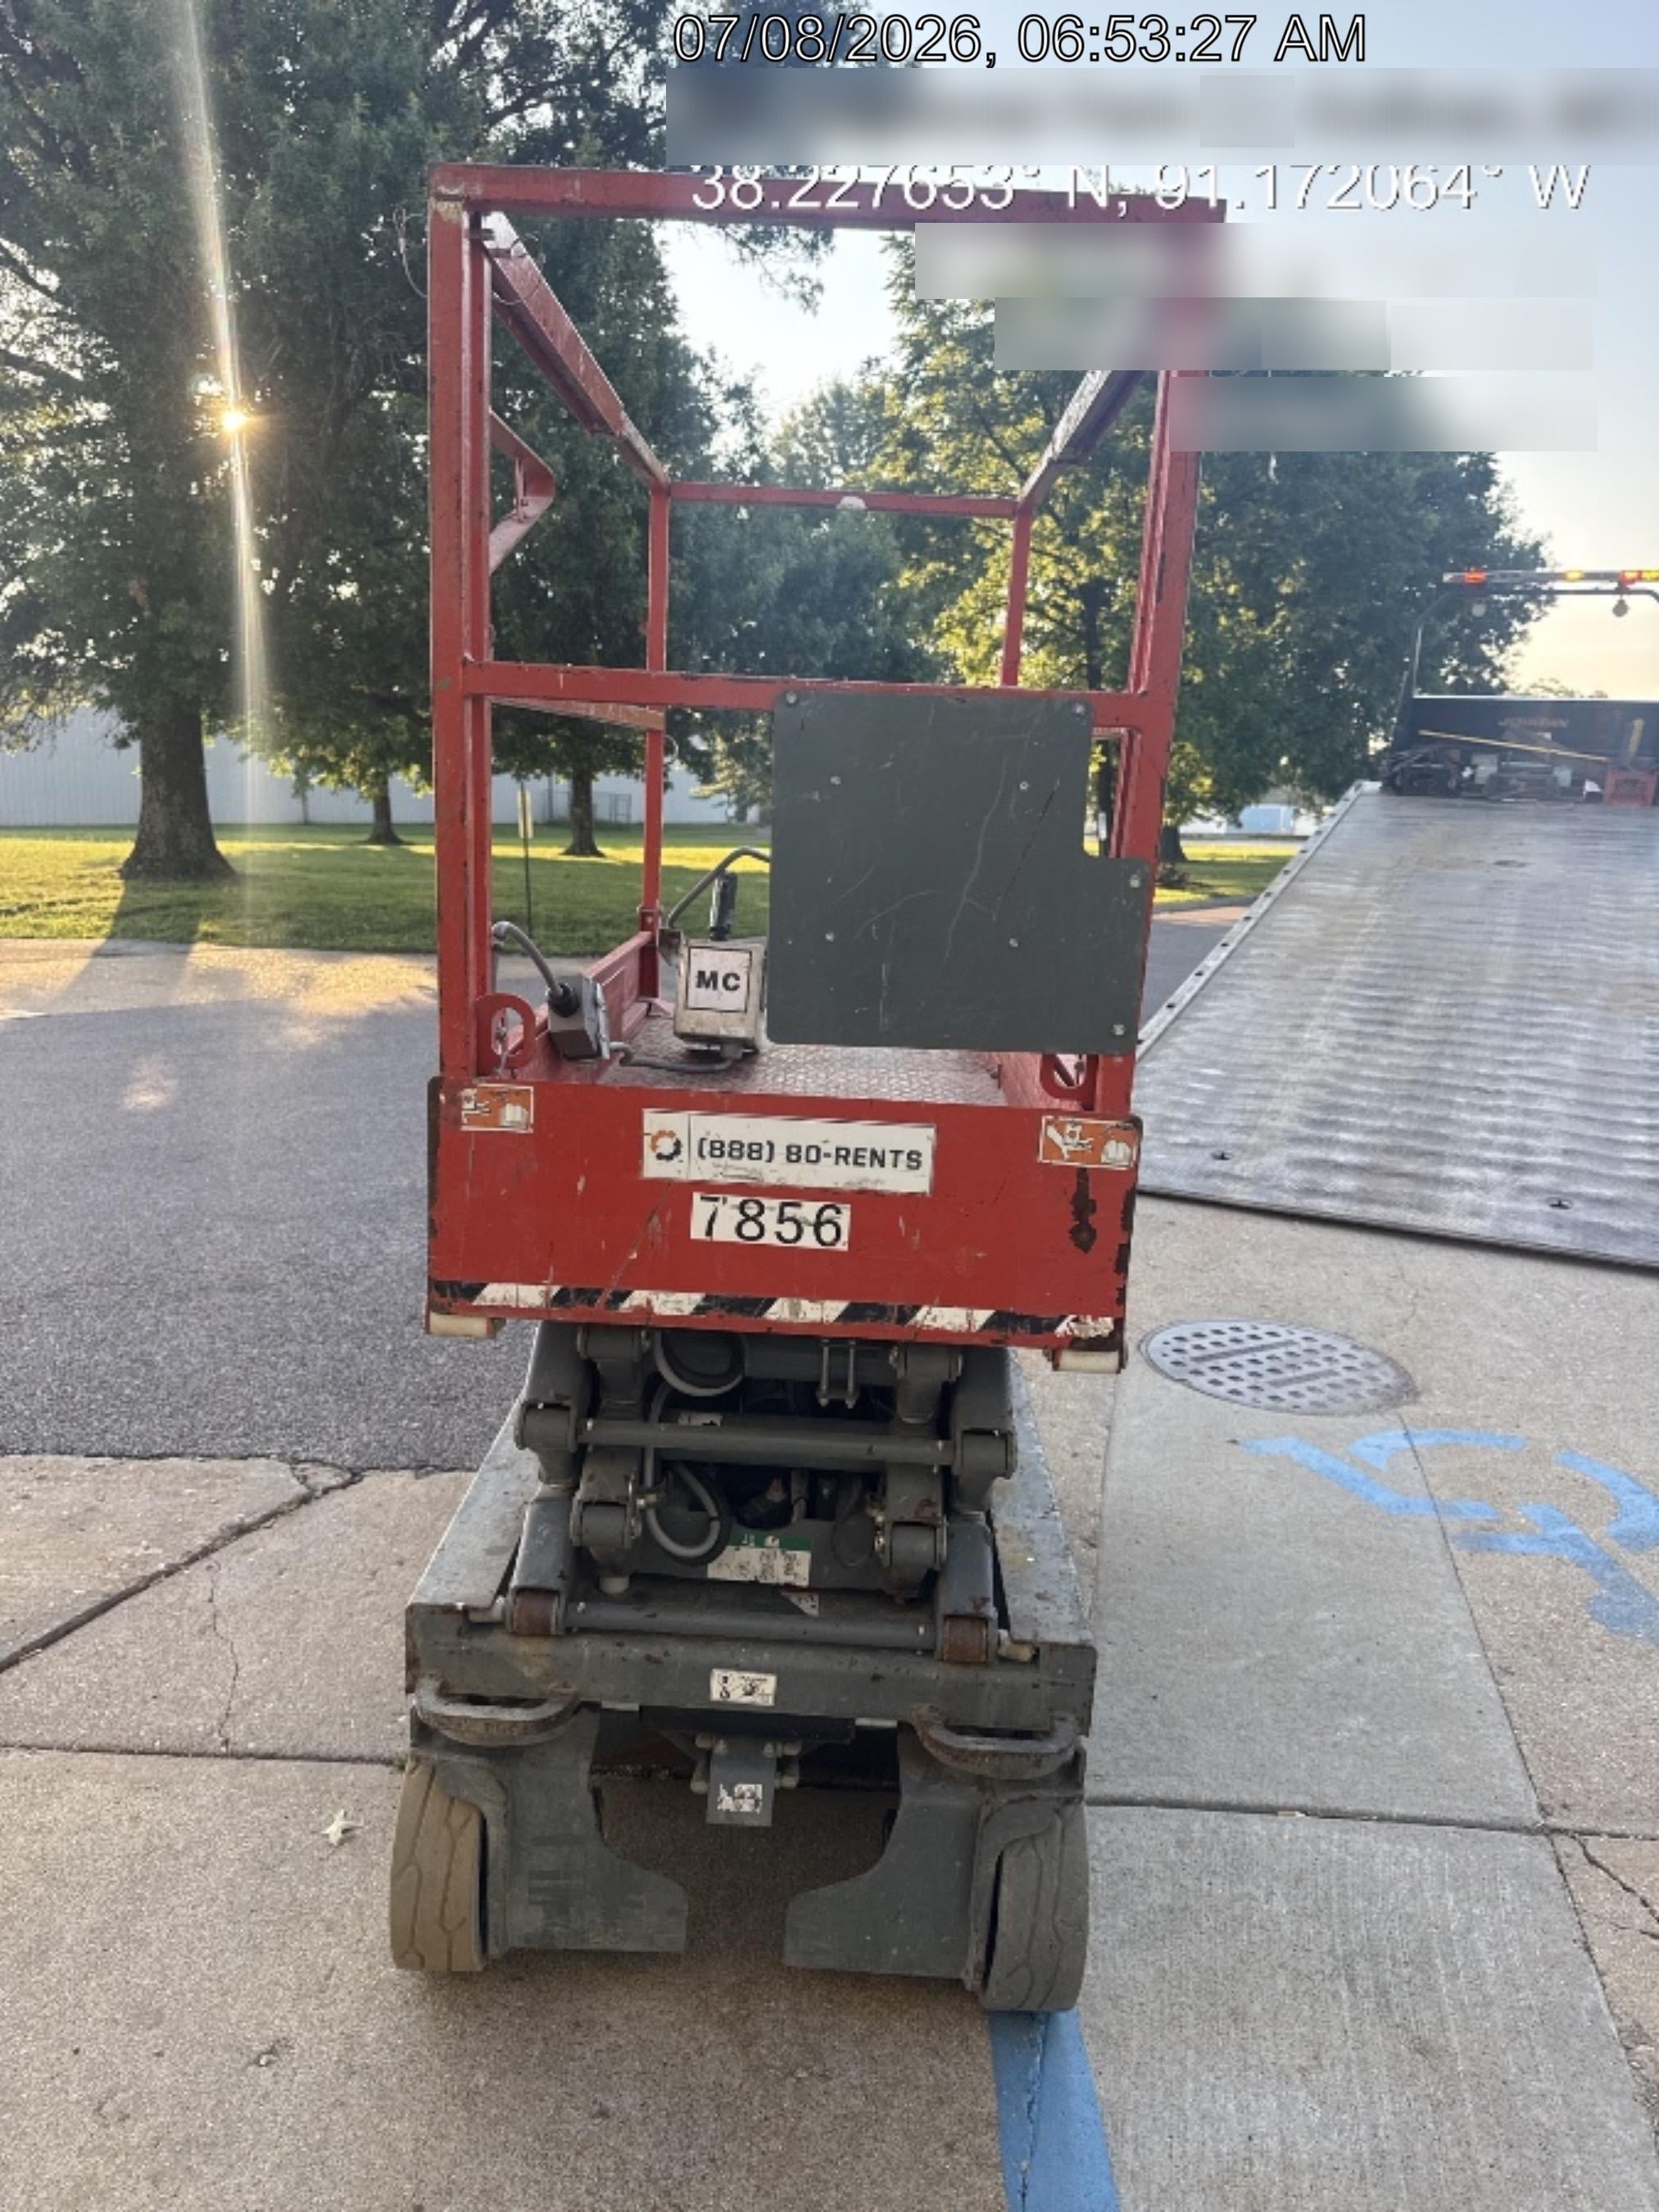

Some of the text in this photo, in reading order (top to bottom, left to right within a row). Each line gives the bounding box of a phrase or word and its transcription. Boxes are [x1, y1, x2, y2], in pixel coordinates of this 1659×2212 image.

[696, 970, 741, 992] MC
[697, 1136, 923, 1171] (888) 80-RENTS
[699, 1195, 843, 1248] 7856
